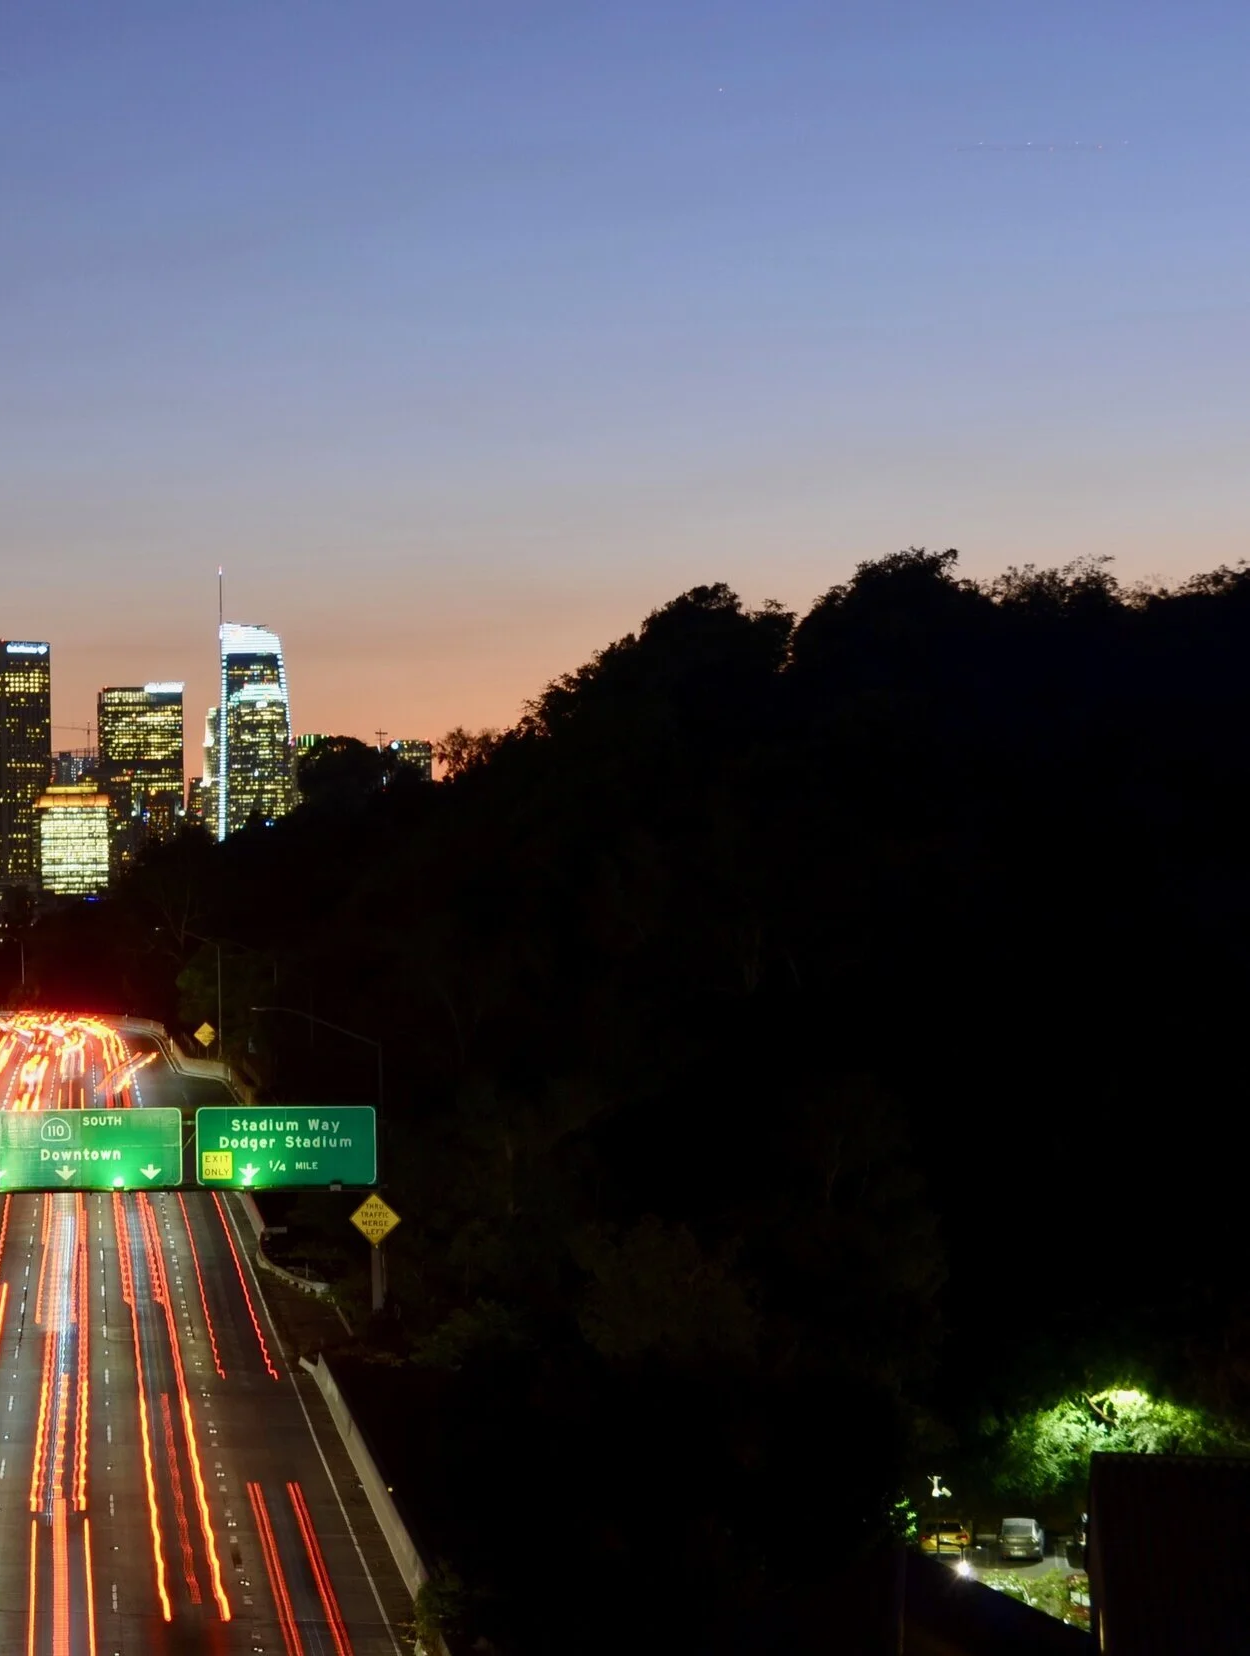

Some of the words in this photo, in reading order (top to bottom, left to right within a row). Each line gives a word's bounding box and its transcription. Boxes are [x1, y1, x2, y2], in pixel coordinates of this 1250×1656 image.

[82, 1116, 122, 1126] SOUTH
[231, 1119, 299, 1132] Stadium
[308, 1119, 340, 1133] Way
[47, 1125, 64, 1137] 110
[219, 1136, 275, 1151] Dodger
[285, 1136, 352, 1148] Stadium
[40, 1149, 121, 1161] Downtown
[205, 1155, 229, 1163] EXIT
[295, 1162, 318, 1170] MILE
[360, 1211, 389, 1219] TRAFFIC
